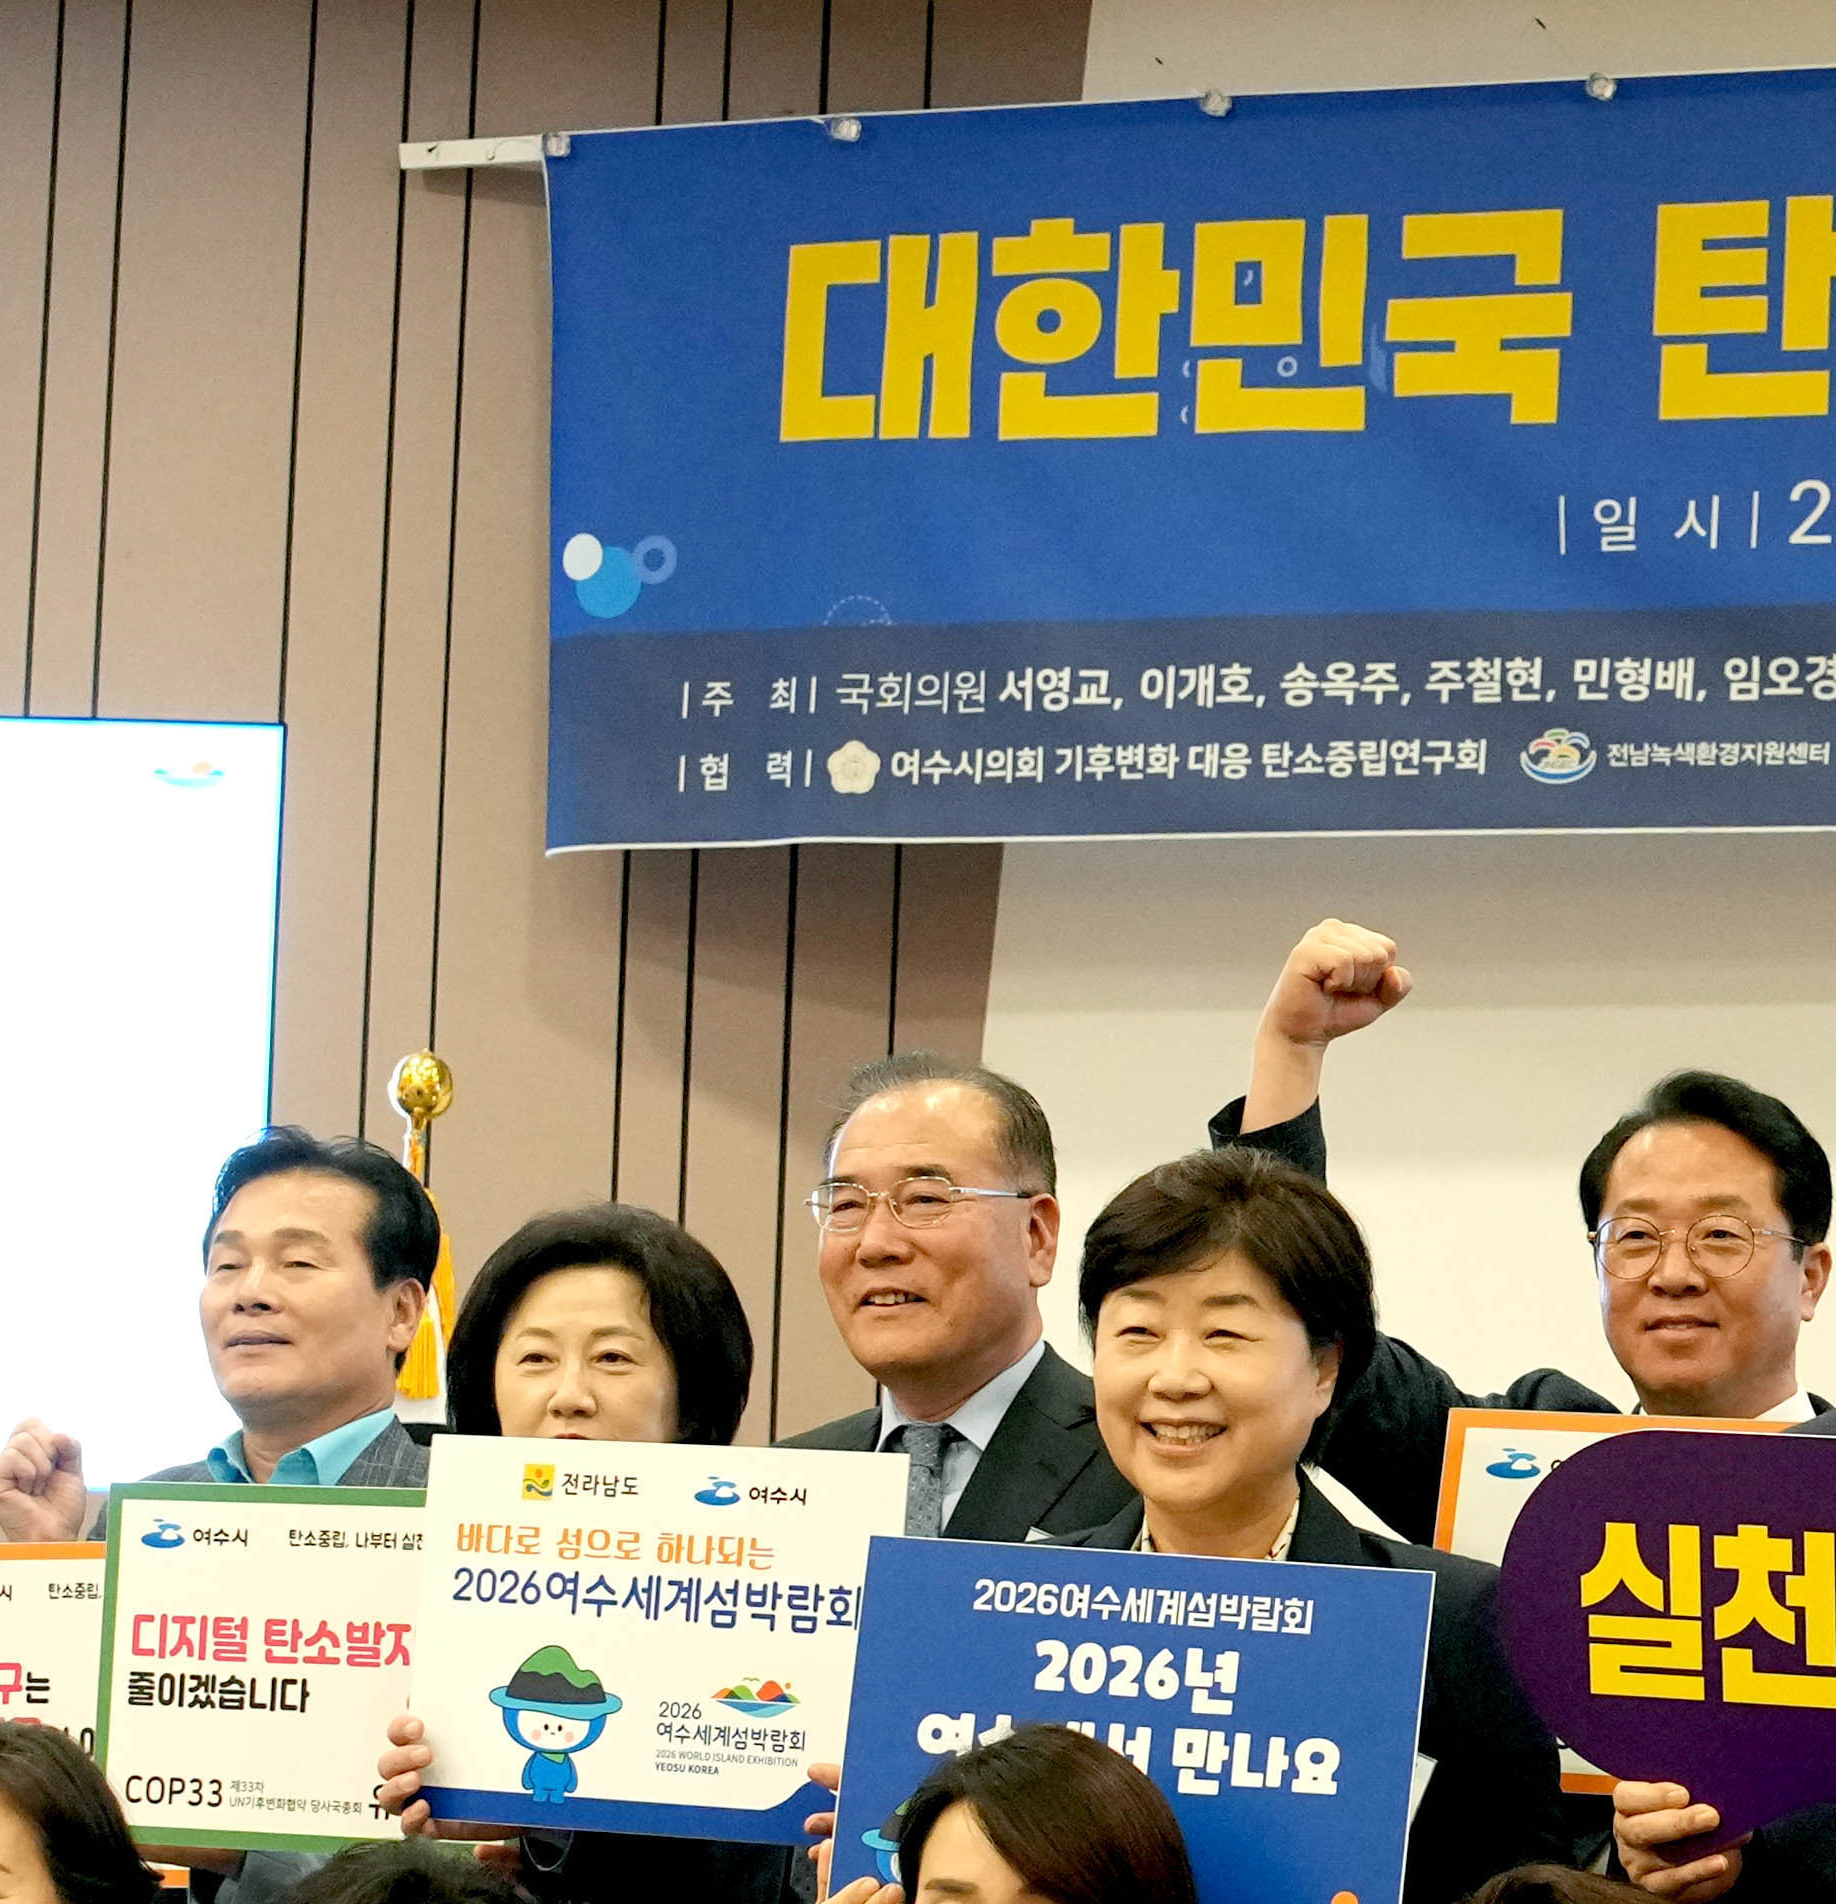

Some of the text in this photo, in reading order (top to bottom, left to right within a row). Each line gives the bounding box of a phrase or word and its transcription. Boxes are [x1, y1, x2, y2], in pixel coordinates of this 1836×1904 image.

[780, 209, 1573, 442] 대한민국
[836, 670, 985, 714] 국회의원
[999, 666, 1123, 712] 서영교,
[1140, 663, 1265, 709] 이개호,
[1280, 662, 1411, 707] 송옥주,
[1425, 656, 1556, 704] 주철현,
[1574, 657, 1707, 702] 민형배,
[891, 746, 1043, 785] 여수시의회
[1055, 743, 1180, 781] 기후변화
[1187, 743, 1252, 779] 대응
[1262, 739, 1487, 778] 탄소중립연구회
[1607, 741, 1830, 767] 전남녹색환경지원센터
[562, 1474, 806, 1505] 전라남도 여수시
[457, 1523, 774, 1570] 바다로 섬으로 하나되는
[451, 1565, 861, 1634] 2026여수세계섬박람회
[973, 1579, 1314, 1634] 2026여수세계섬박람회
[132, 1614, 248, 1662] 디지털
[128, 1672, 309, 1713] 줄이겠습니다
[1035, 1640, 1239, 1715] 2026년
[657, 1722, 805, 1753] 여수세계섬박람회
[655, 1762, 720, 1775] YEOSU KOREA
[1172, 1728, 1340, 1795] 만나요
[126, 1775, 222, 1807] COP33
